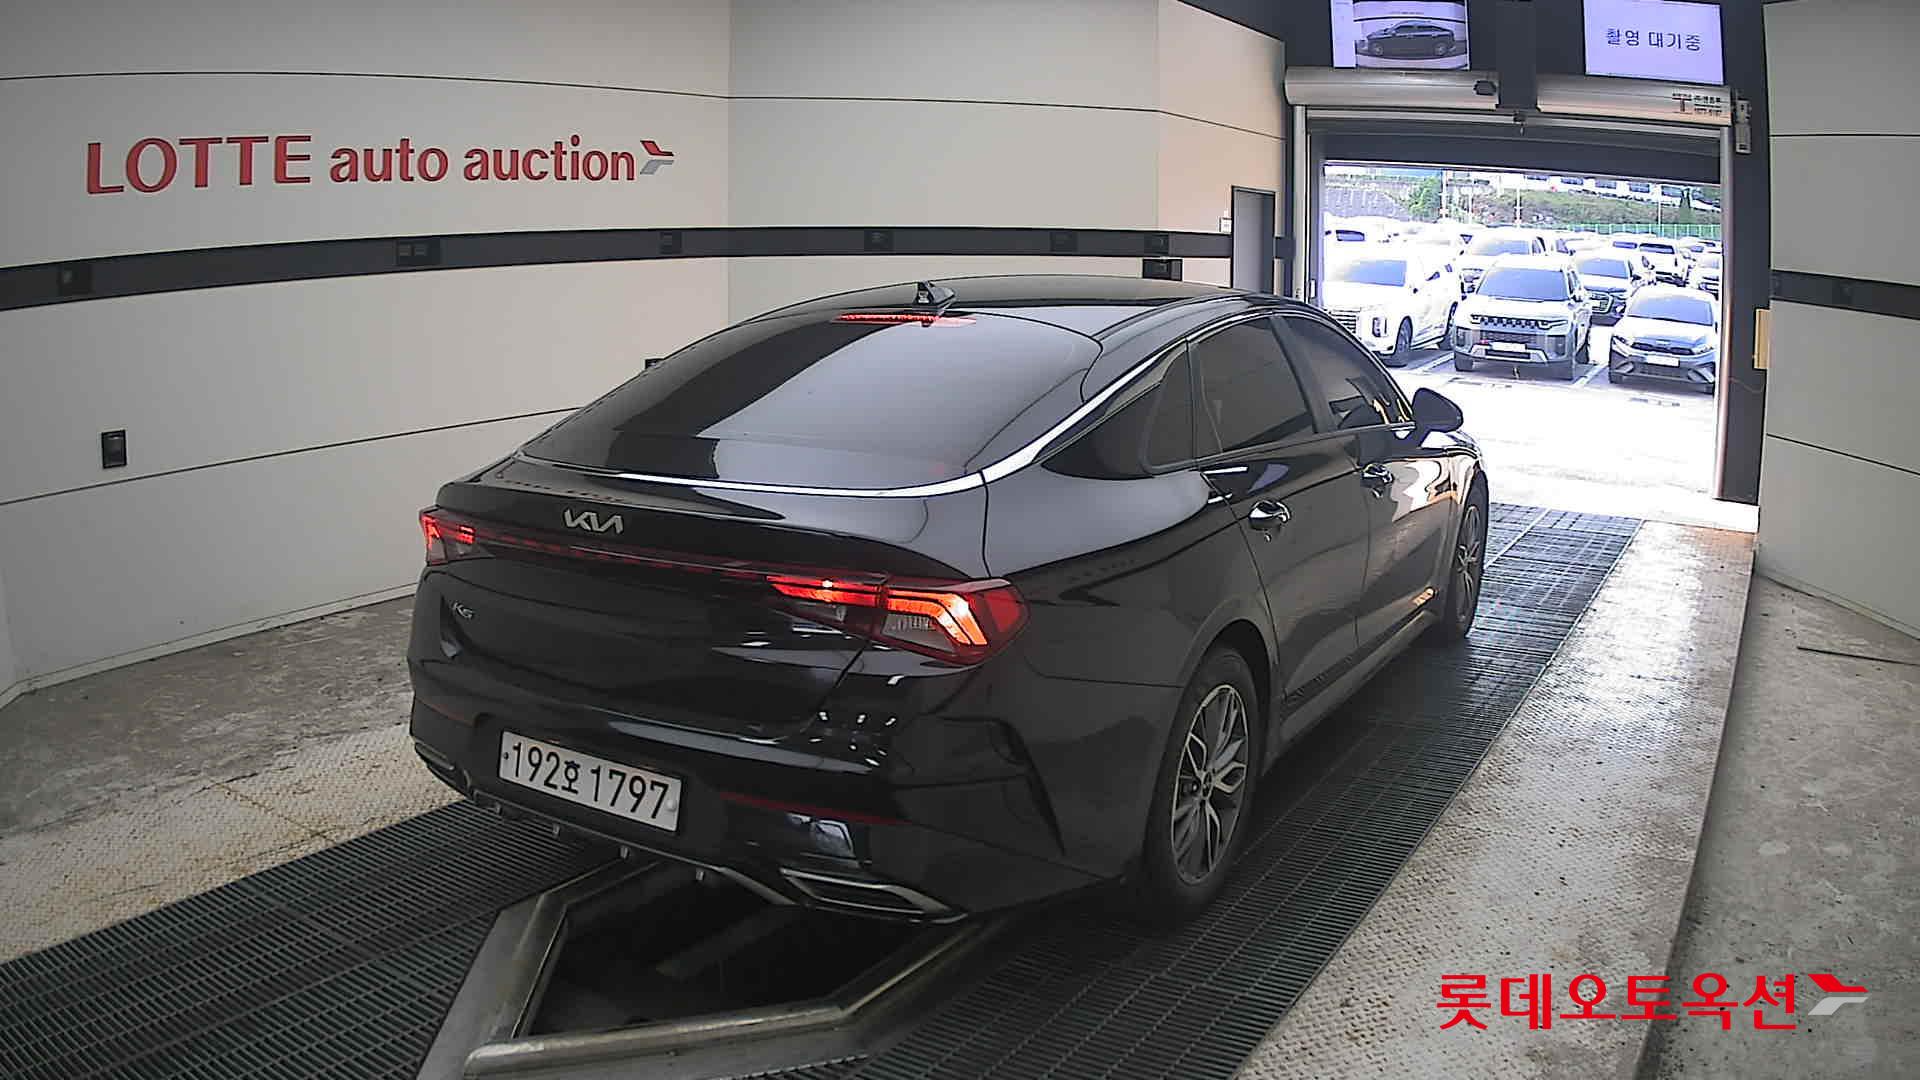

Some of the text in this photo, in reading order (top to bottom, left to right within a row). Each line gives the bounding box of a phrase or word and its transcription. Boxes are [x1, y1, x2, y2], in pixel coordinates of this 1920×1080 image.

[1606, 28, 1701, 52] 촬영 대기중
[87, 134, 637, 194] LOTTE auto auction
